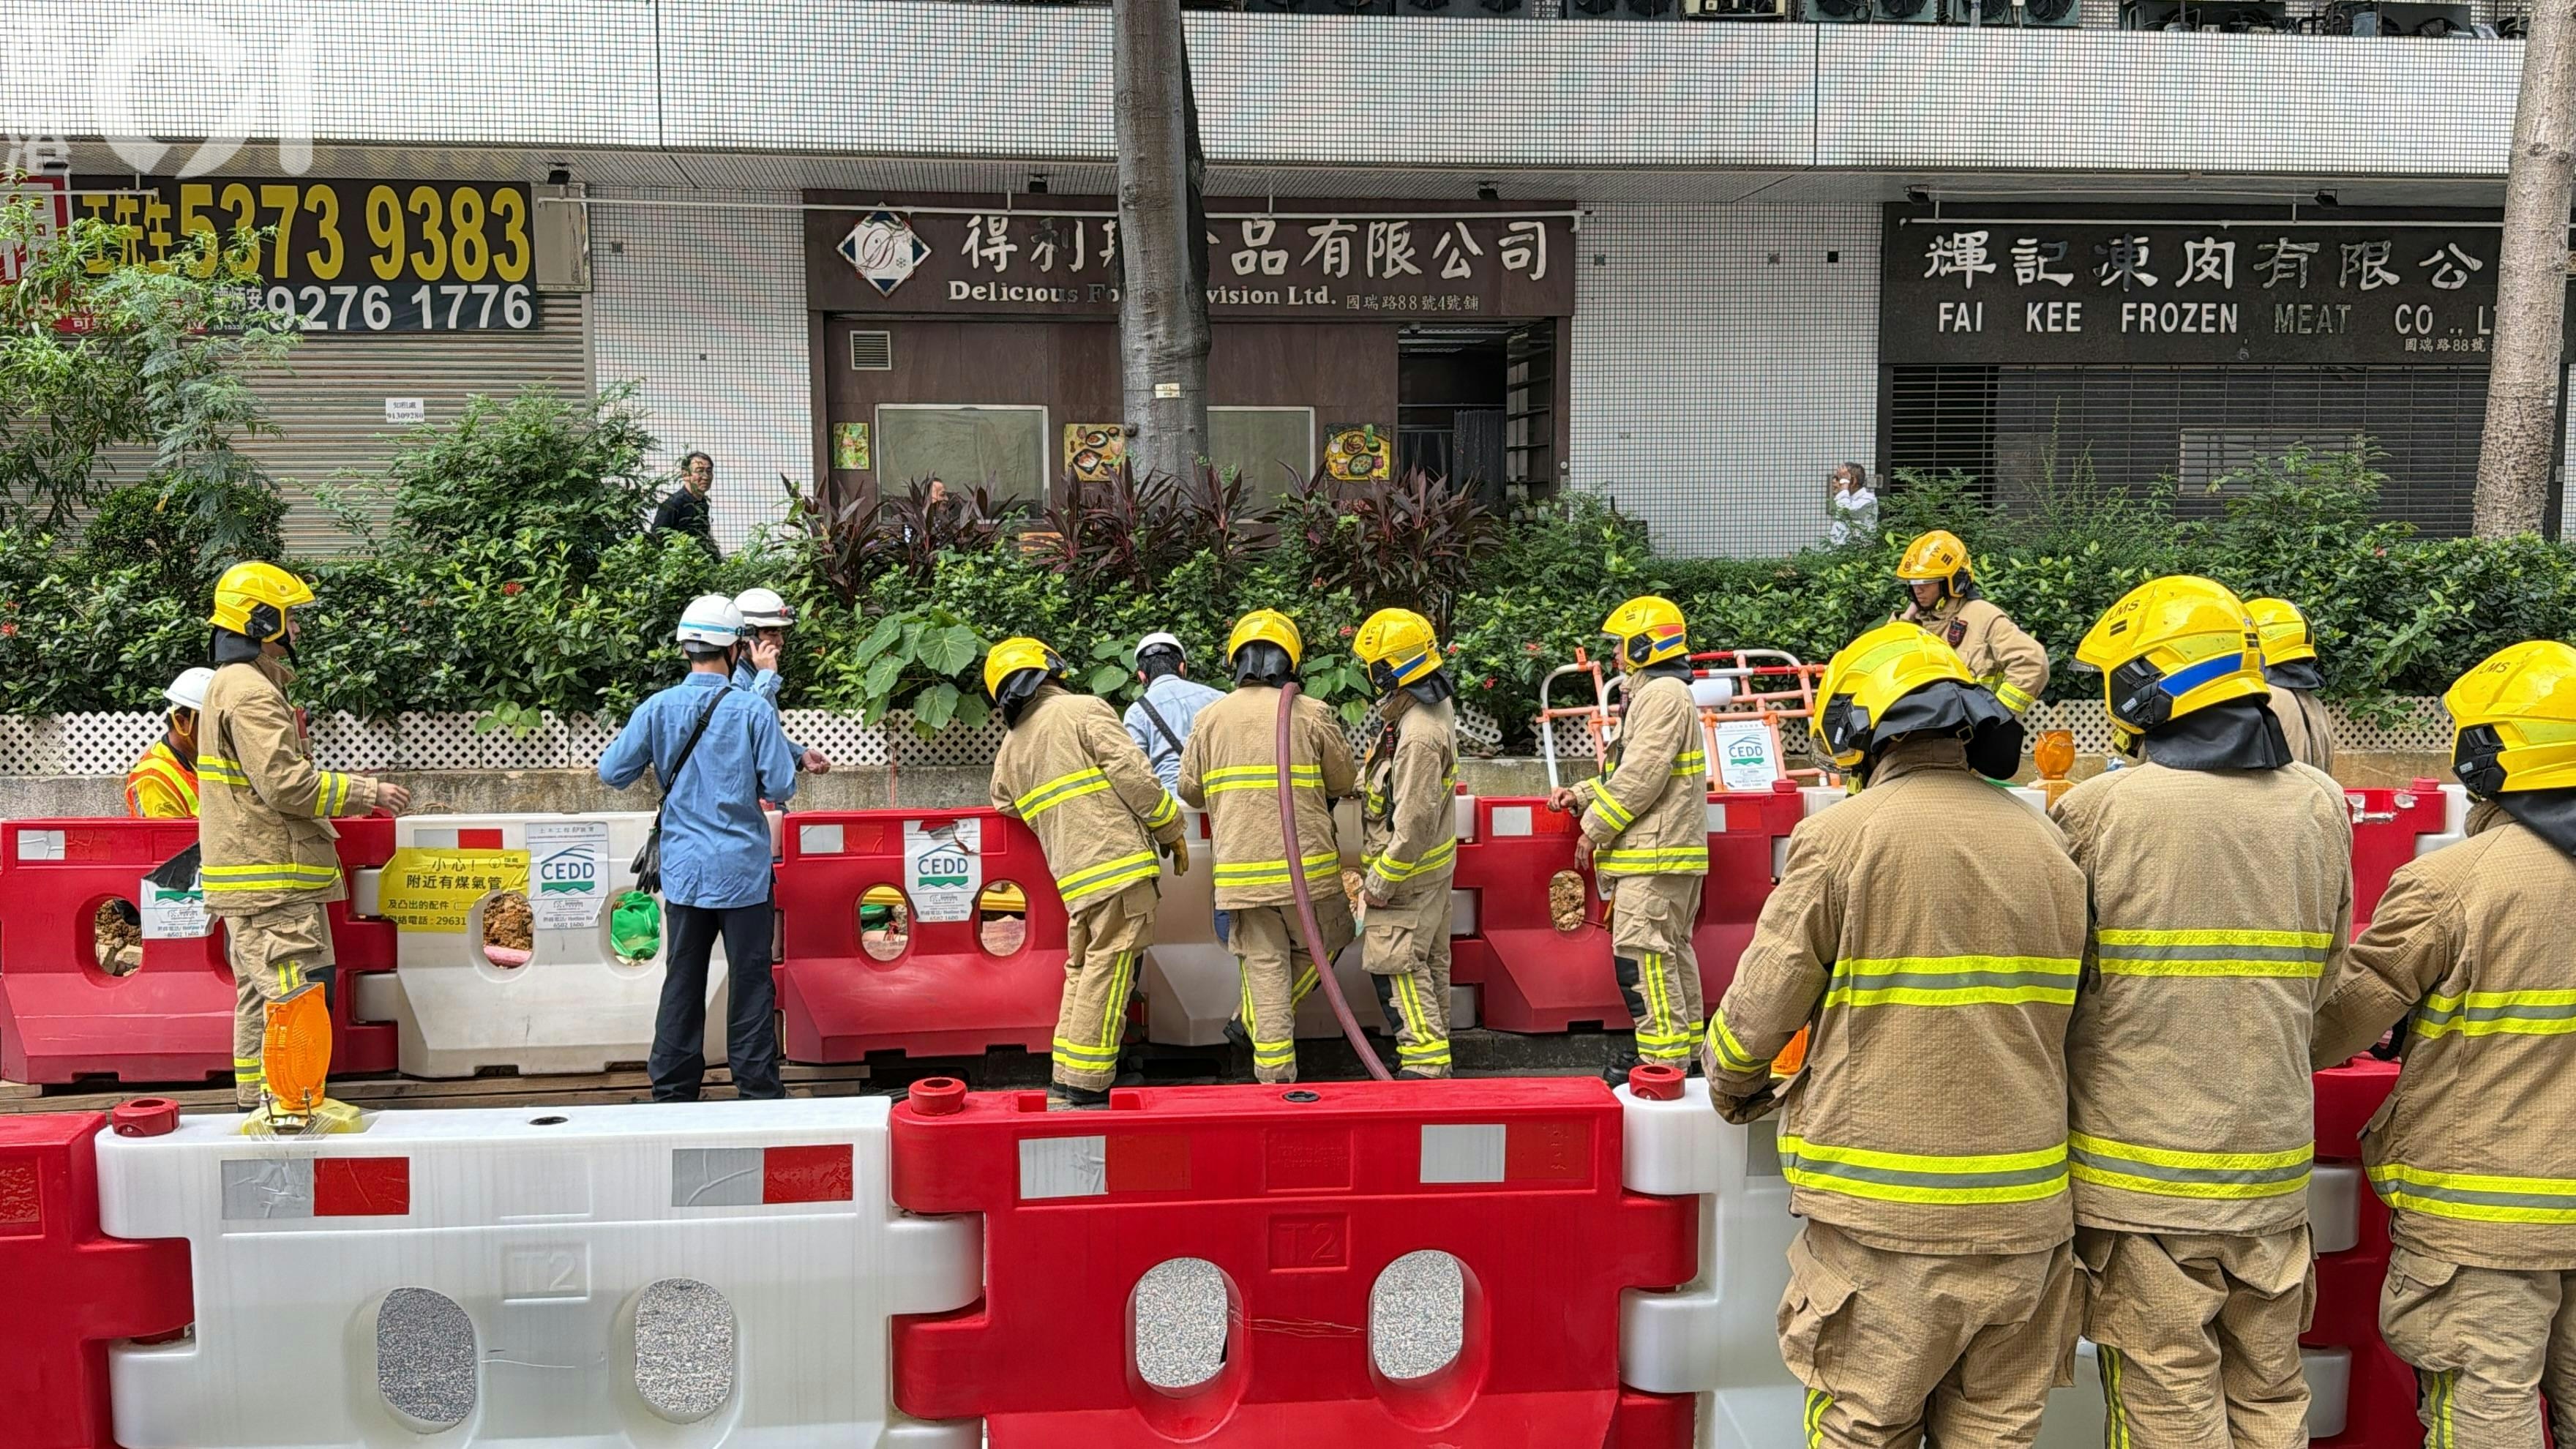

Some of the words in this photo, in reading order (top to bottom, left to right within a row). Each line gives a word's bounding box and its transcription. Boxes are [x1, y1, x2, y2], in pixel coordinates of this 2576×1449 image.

[180, 184, 344, 281] 5373
[365, 184, 531, 282] 9383
[961, 214, 1546, 281] 得利品有限公司
[948, 280, 1079, 303] Delicious
[1206, 285, 1280, 305] vision
[1287, 285, 1337, 306] Ltd.
[266, 285, 392, 331] 9276
[410, 283, 532, 330] 1776
[1938, 302, 1983, 334] FAI
[2026, 302, 2082, 334] KEE
[2120, 302, 2238, 334] FROZEN
[2274, 304, 2352, 335] MEAT
[2477, 305, 2497, 335] L
[2107, 599, 2141, 622] LMS
[1729, 746, 1763, 757] CEDD
[540, 862, 595, 880] CEDD
[917, 858, 969, 875] CEDD
[406, 875, 503, 890] 附近有煤氣管
[514, 1252, 577, 1292] T2
